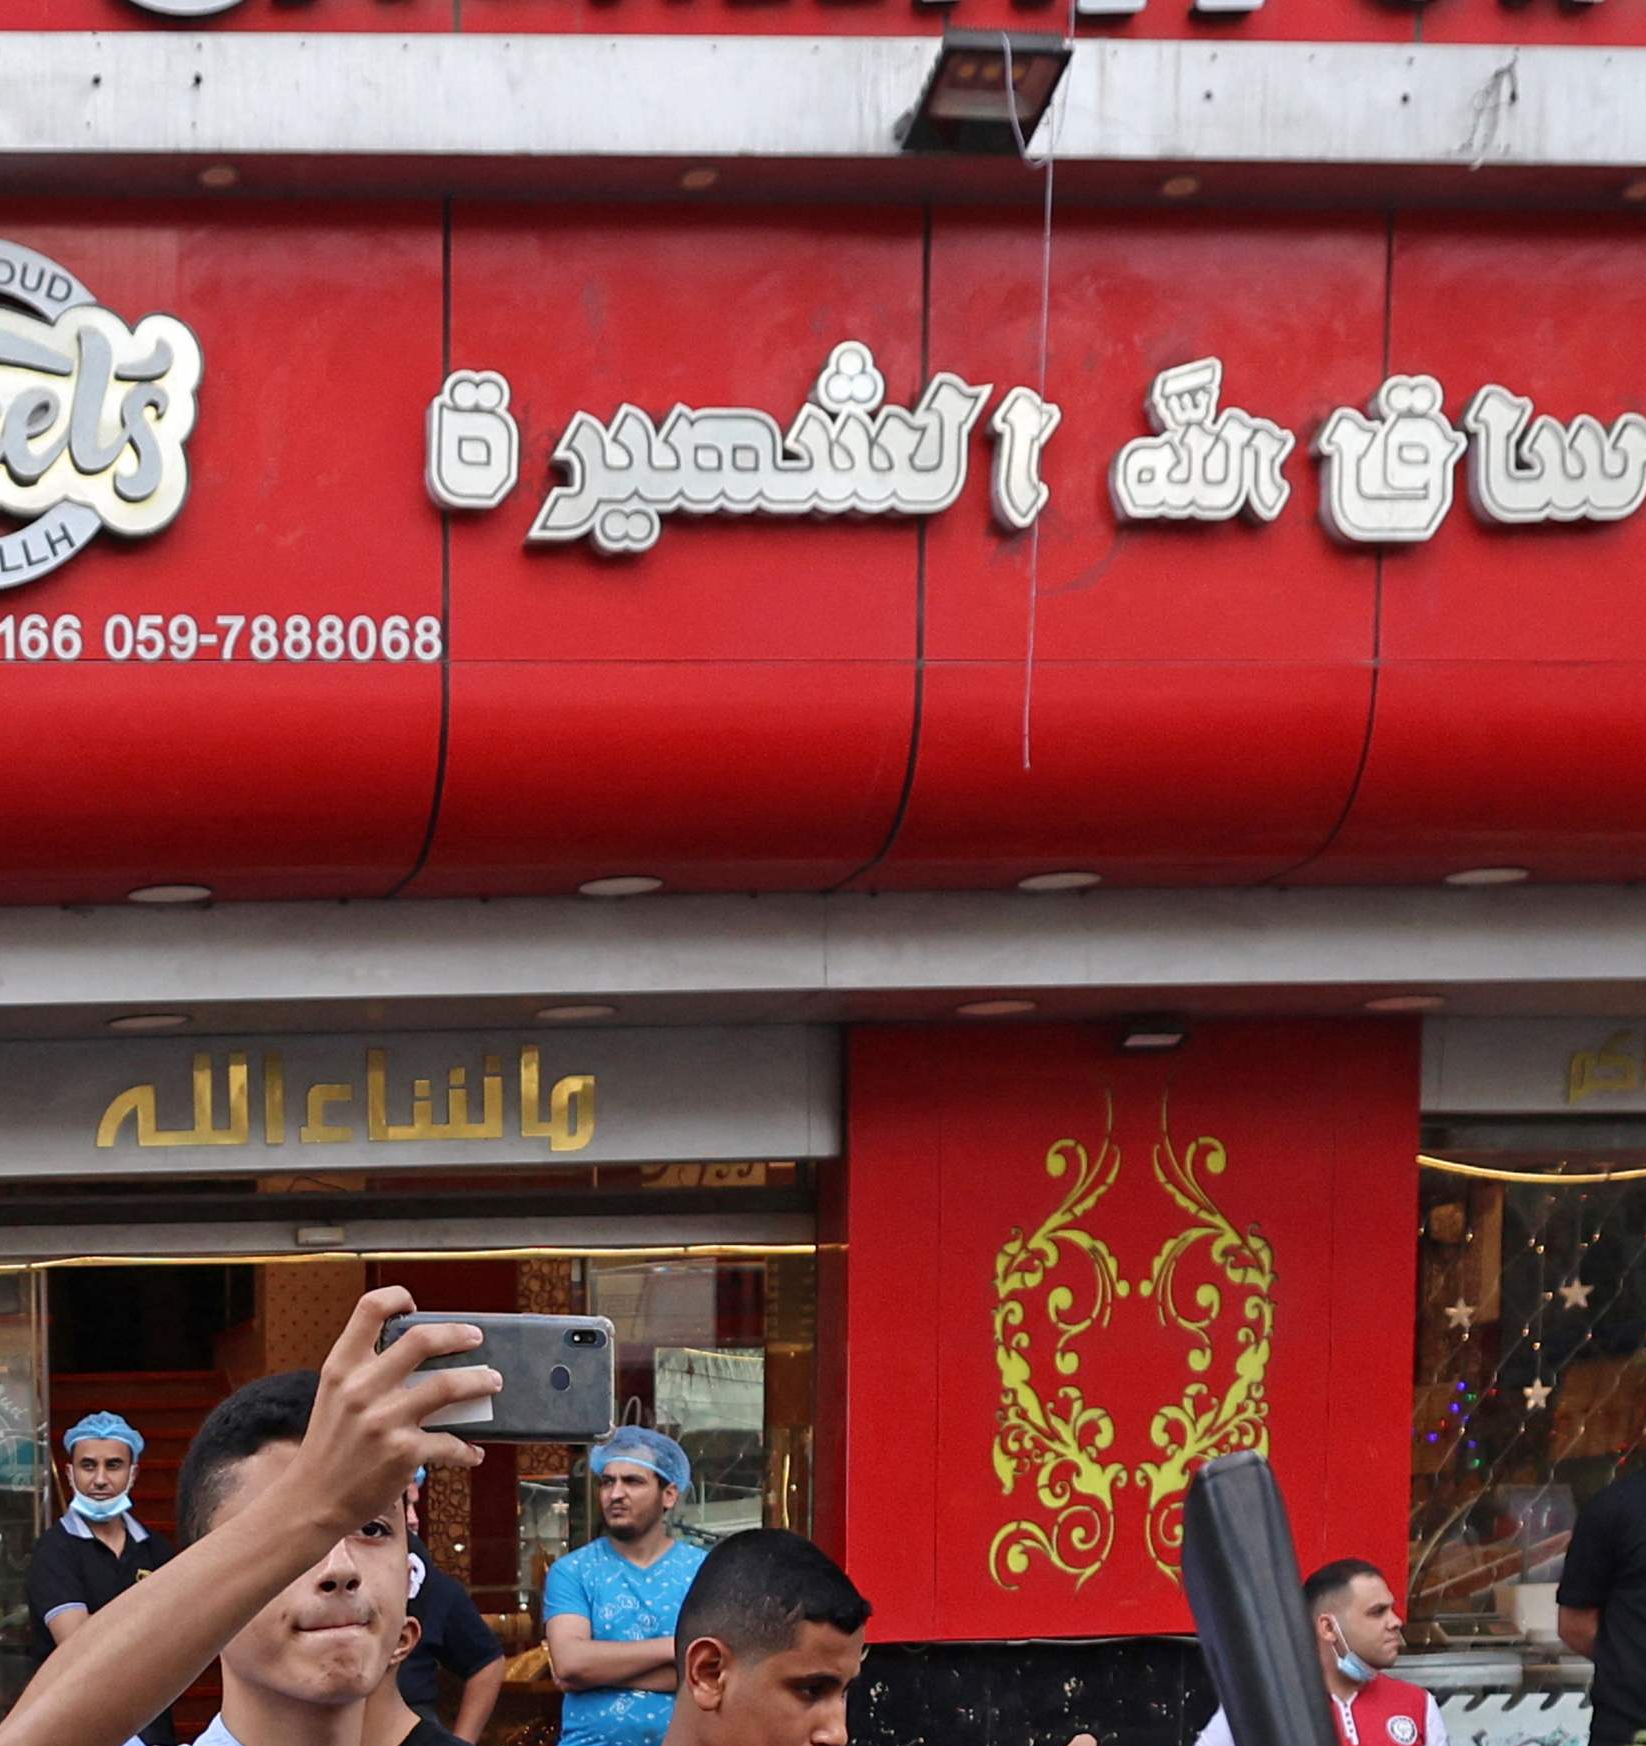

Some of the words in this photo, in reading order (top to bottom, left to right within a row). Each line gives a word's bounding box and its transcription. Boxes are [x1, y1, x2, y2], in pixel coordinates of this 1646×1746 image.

[426, 340, 1061, 555] الشهيرة
[104, 614, 443, 663] 059-7888068
[96, 1048, 286, 1149] الله
